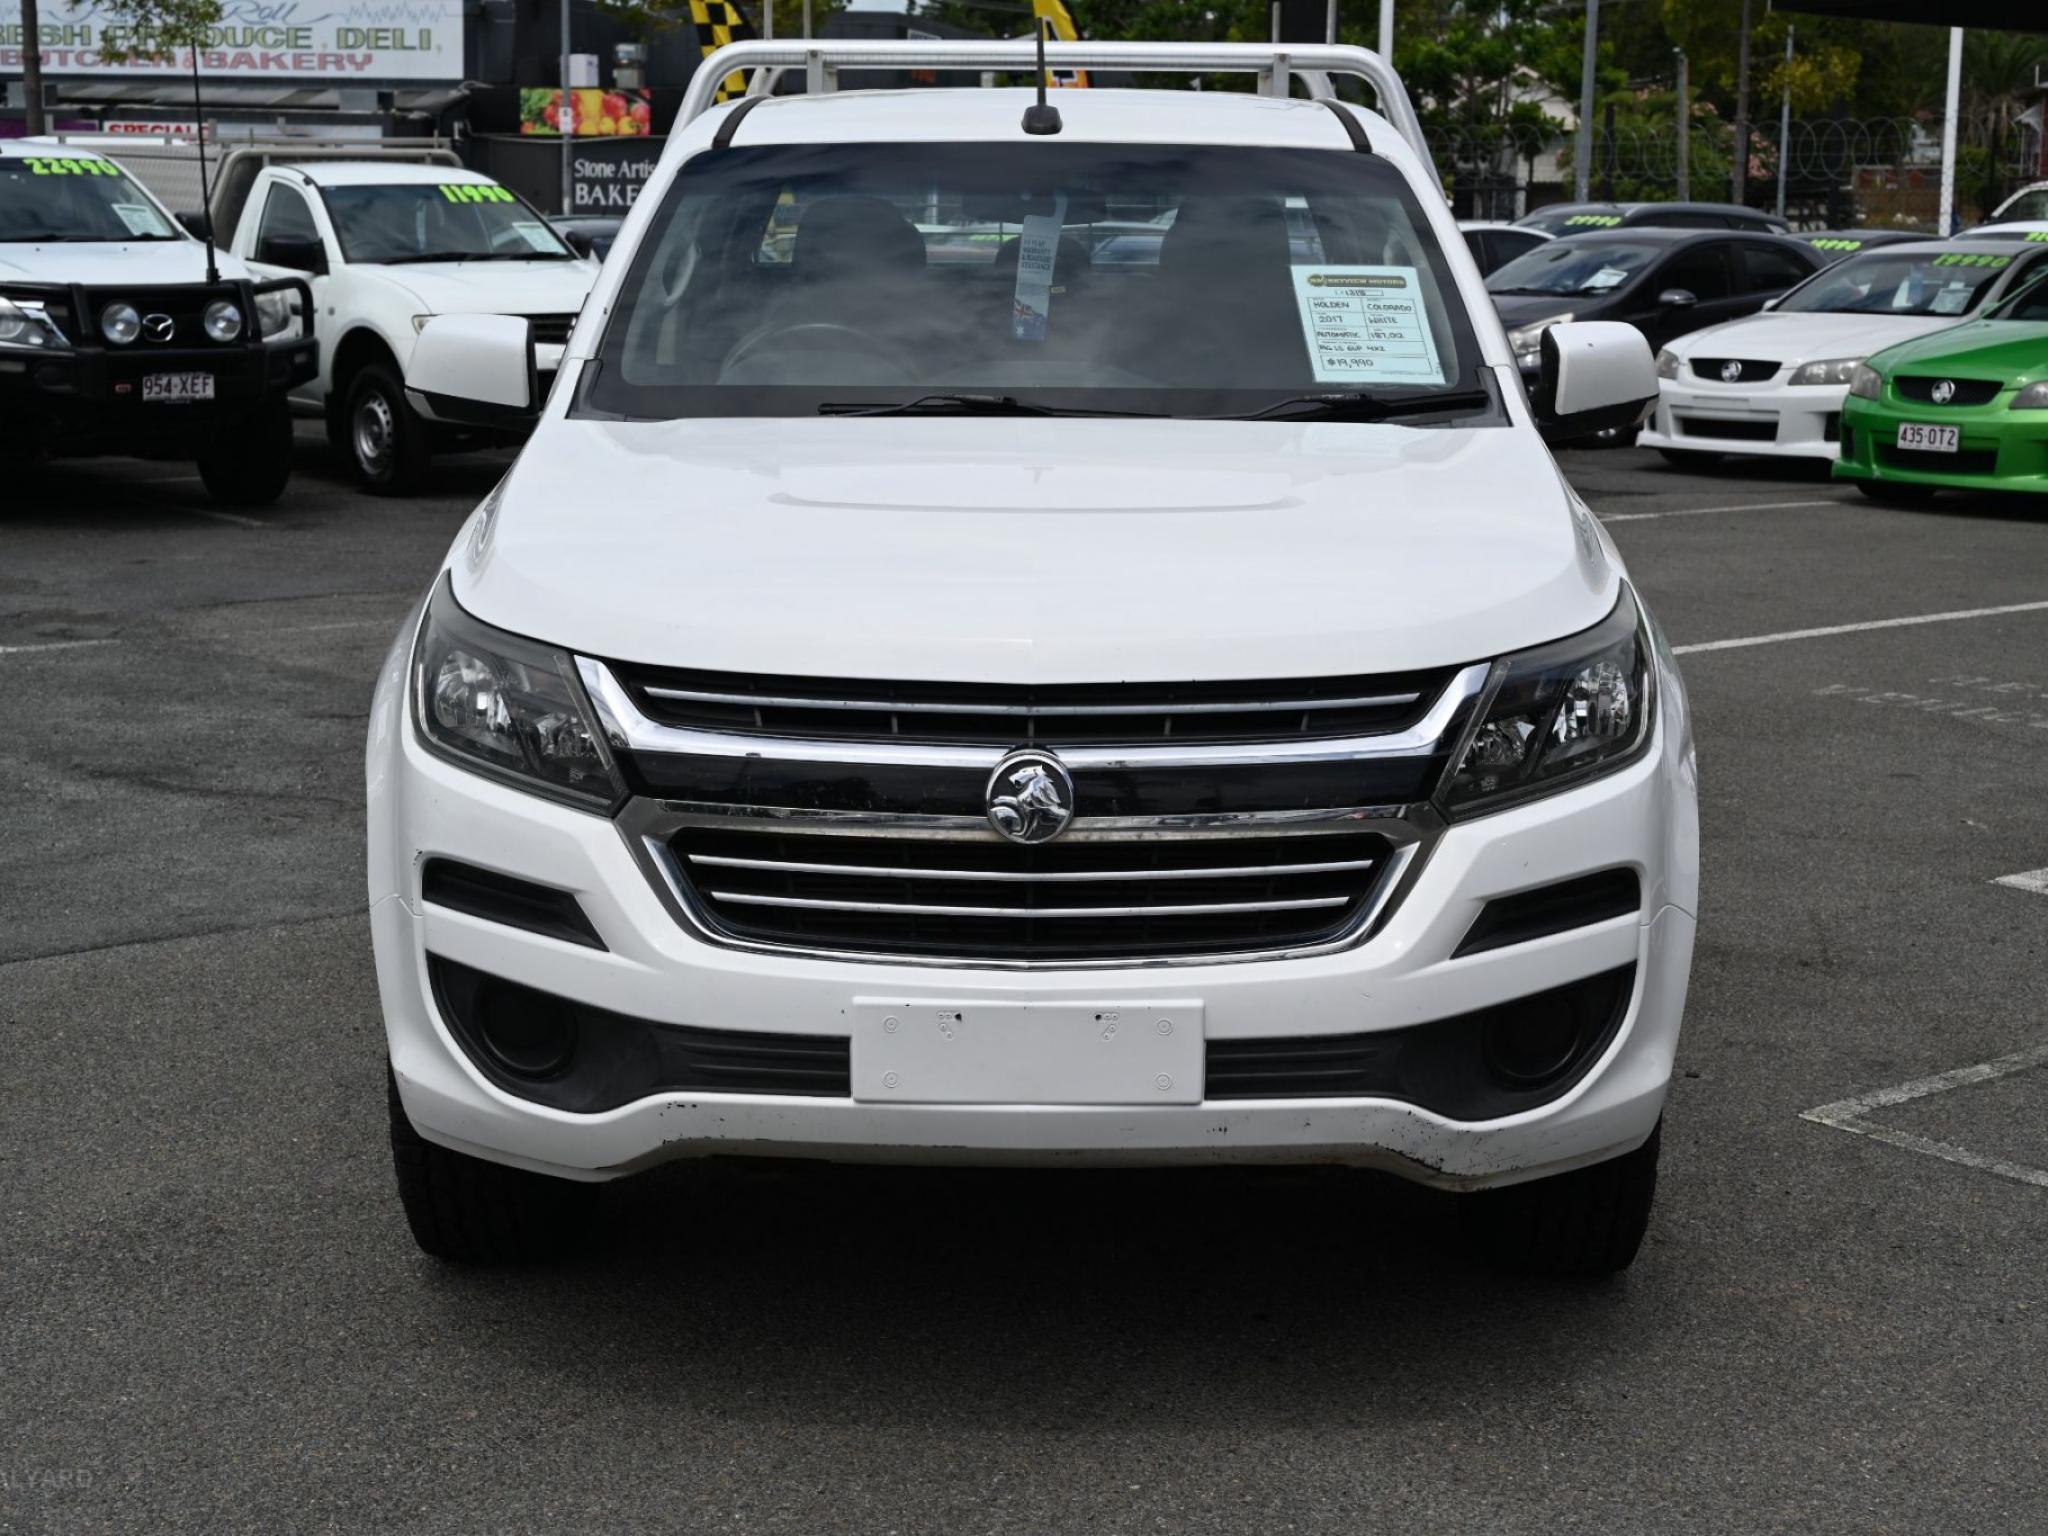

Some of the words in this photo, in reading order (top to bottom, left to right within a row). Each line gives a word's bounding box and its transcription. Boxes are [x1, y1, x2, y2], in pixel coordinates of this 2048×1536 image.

[202, 51, 373, 70] BAKERY
[22, 158, 119, 176] 22990
[574, 158, 616, 178] Stone
[438, 184, 516, 203] 11990
[1313, 301, 1349, 309] HOLDEN
[1366, 303, 1412, 312] COLORADO
[1319, 315, 1343, 323] 2017
